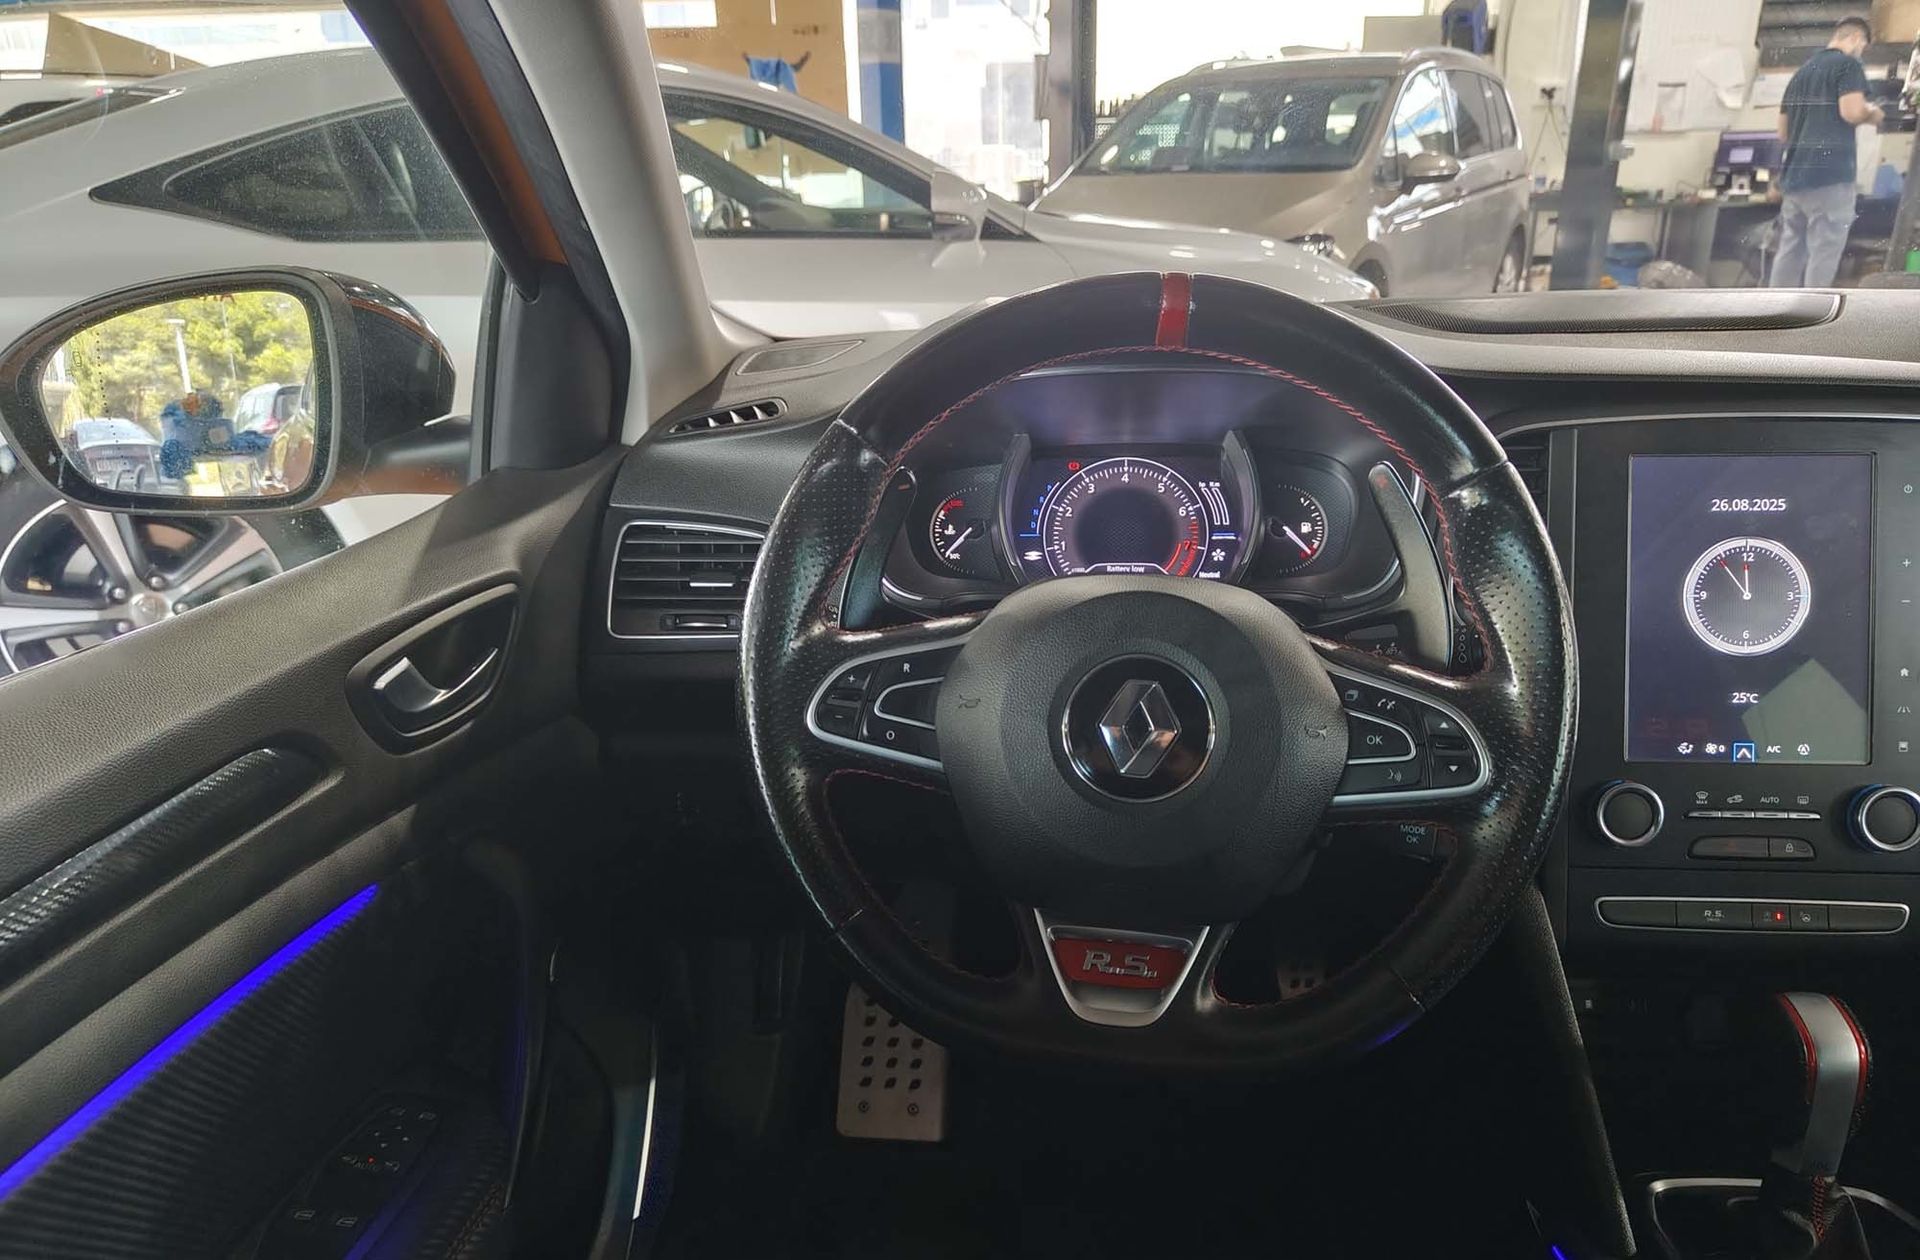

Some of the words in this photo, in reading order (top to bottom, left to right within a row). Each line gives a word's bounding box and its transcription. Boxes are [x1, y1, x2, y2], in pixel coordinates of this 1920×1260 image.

[1121, 473, 1130, 483] 4
[1087, 484, 1095, 493] 3
[1158, 484, 1165, 493] 5
[1711, 499, 1787, 512] 26.08.2025
[1065, 507, 1073, 517] 2
[1179, 507, 1187, 516] 6
[1742, 552, 1755, 563] 12
[1106, 566, 1130, 574] Battery
[1131, 565, 1145, 573] low
[1700, 591, 1707, 601] 9
[1787, 591, 1794, 601] 3
[1742, 629, 1750, 639] 6
[903, 663, 911, 673] R
[1732, 691, 1759, 704] 25°C
[1366, 735, 1383, 745] OK
[1766, 745, 1781, 754] A/C
[1760, 796, 1780, 804] AUTO
[1400, 824, 1426, 835] MODE
[1406, 835, 1420, 844] OK
